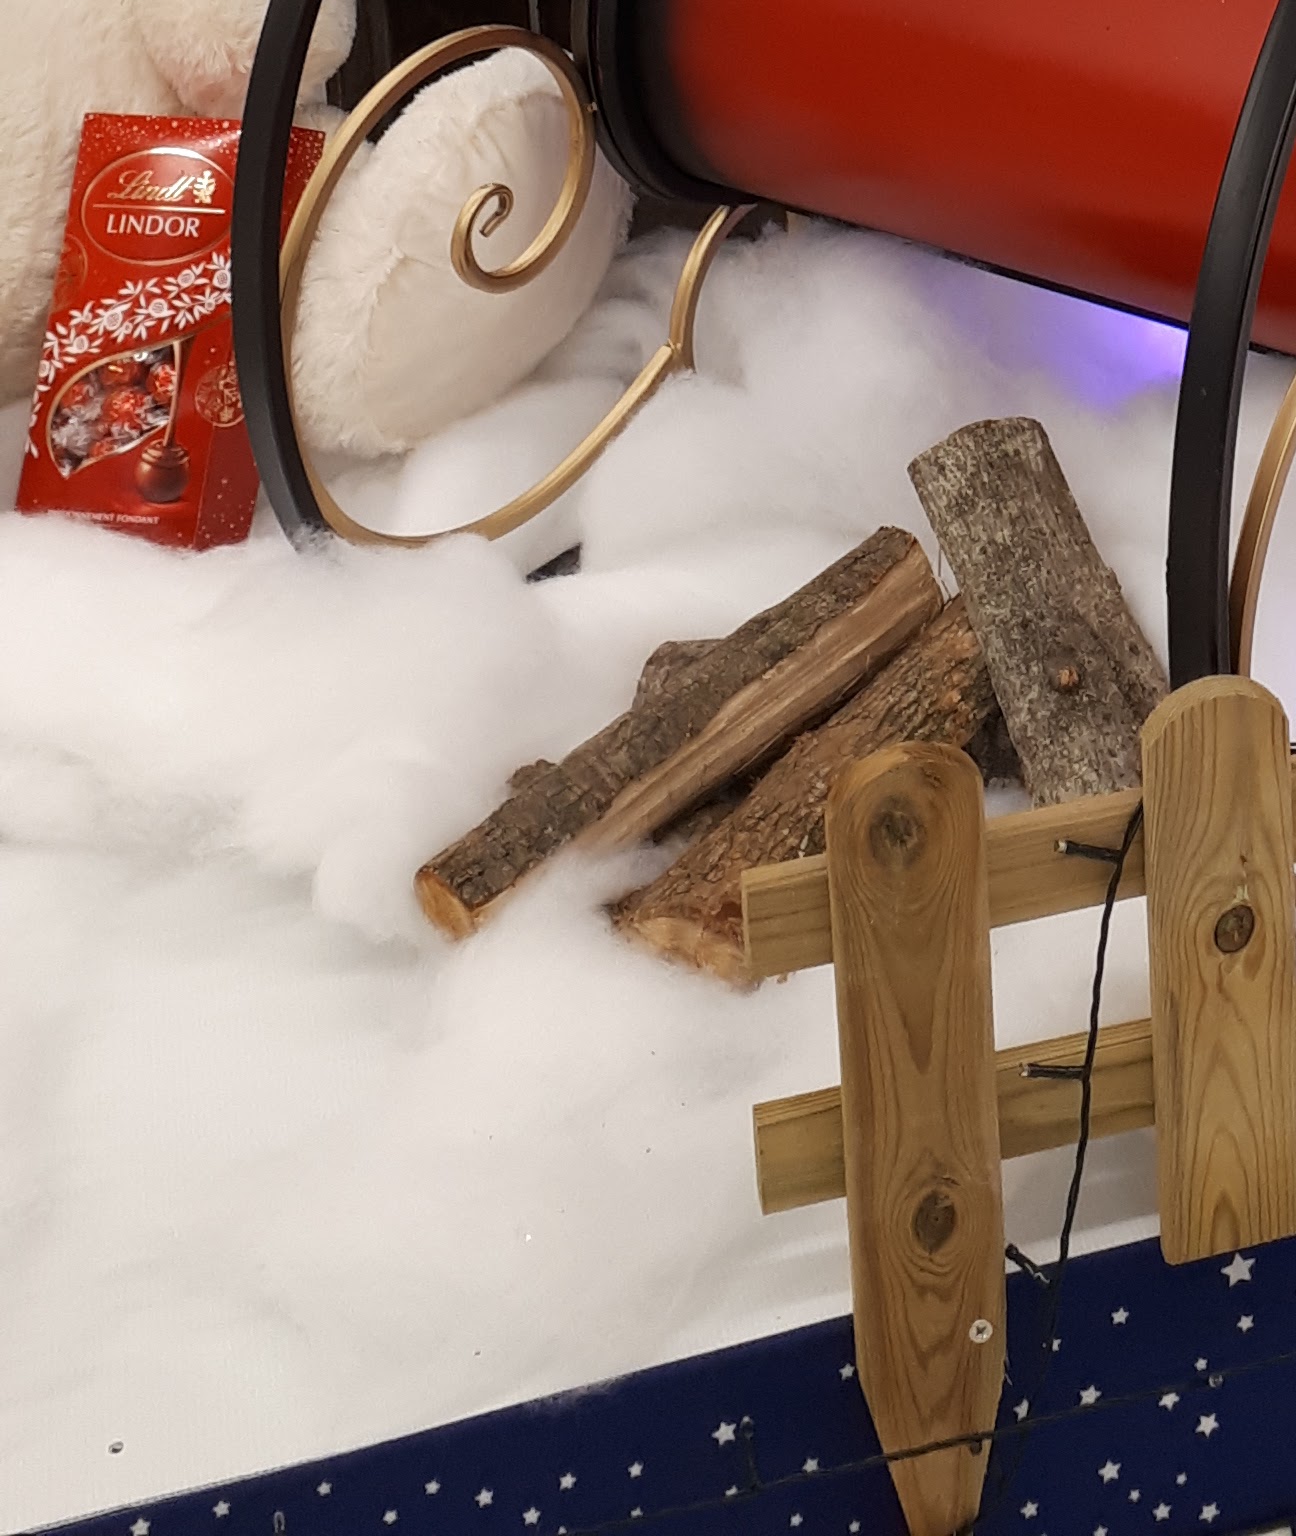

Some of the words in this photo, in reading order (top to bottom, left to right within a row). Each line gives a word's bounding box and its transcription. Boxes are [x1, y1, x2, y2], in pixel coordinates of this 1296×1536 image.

[107, 170, 196, 203] Lindt
[106, 213, 200, 238] LINDOR
[116, 514, 160, 525] FONDANT
